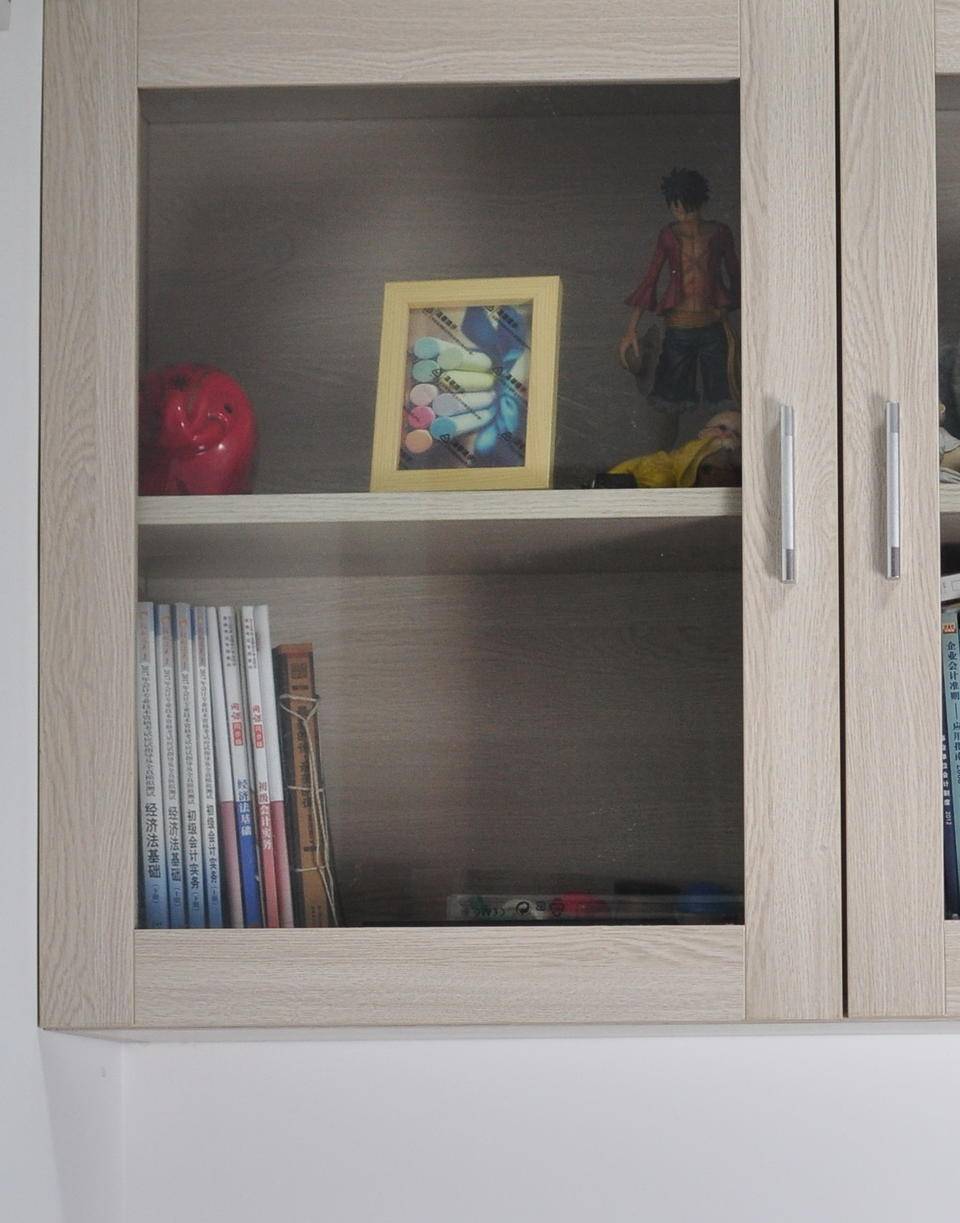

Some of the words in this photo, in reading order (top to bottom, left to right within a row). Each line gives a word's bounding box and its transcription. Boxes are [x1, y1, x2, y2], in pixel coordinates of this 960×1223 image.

[145, 802, 161, 879] 经济法基础
[168, 806, 181, 882] 经济法基础
[187, 809, 200, 889] 初级会计实务
